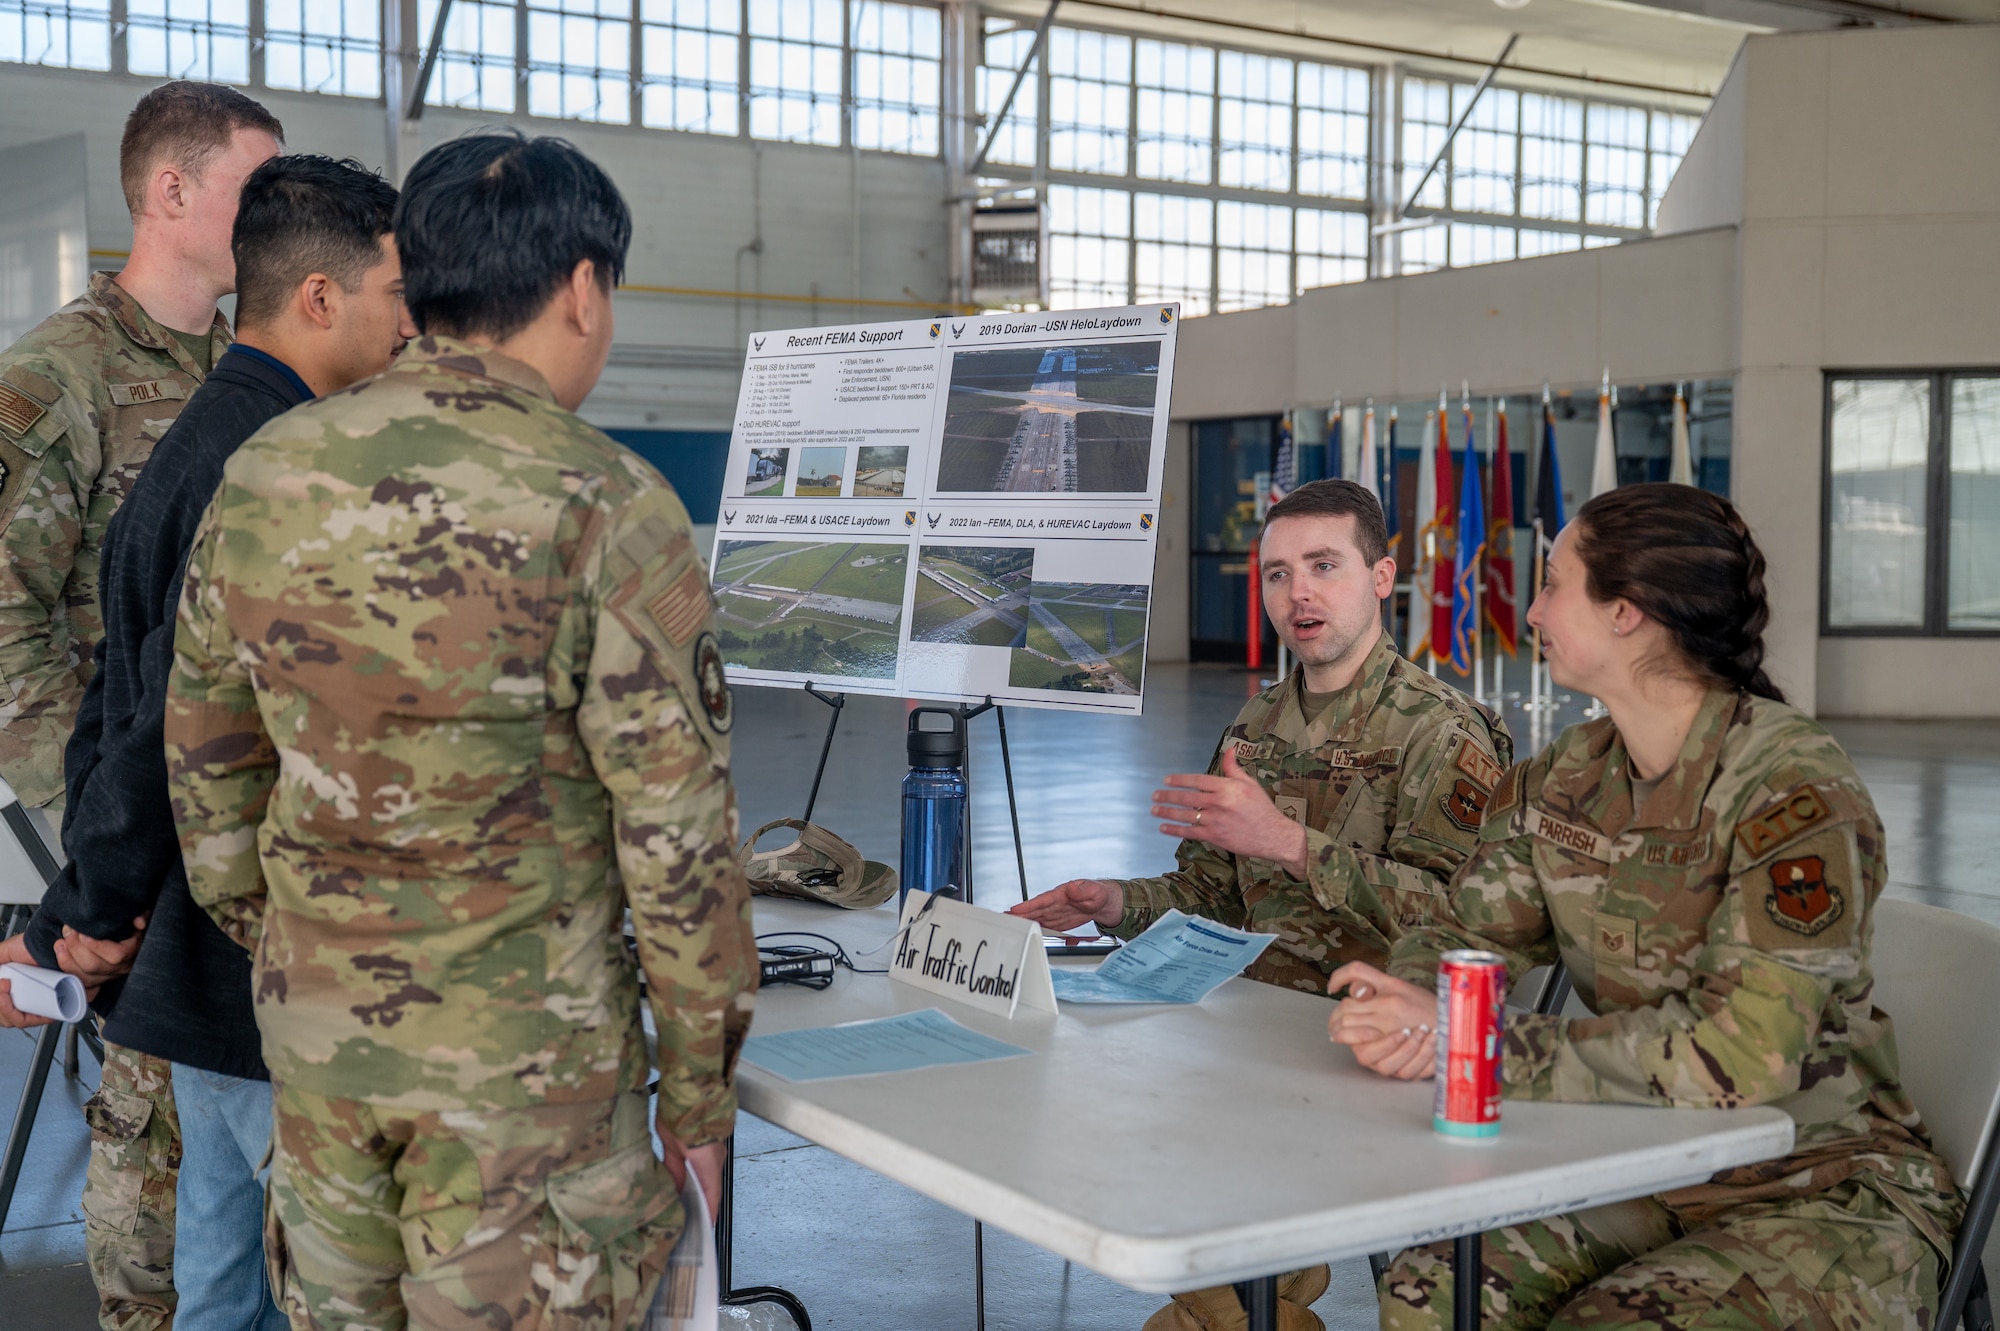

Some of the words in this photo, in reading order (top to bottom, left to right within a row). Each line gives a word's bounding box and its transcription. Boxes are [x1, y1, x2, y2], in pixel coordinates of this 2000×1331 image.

[979, 324, 1002, 336] 2019
[1004, 323, 1036, 334] Dorian
[1070, 317, 1141, 331] HeloLaydown
[787, 335, 823, 347] Recent
[824, 332, 855, 345] FEMA
[859, 329, 904, 344] Support
[129, 382, 162, 401] POLK
[782, 420, 800, 428] support
[746, 515, 764, 524] 2021
[765, 515, 778, 524] Ida
[811, 515, 816, 524] &
[819, 516, 850, 525] USACE
[851, 516, 890, 527] Laydown
[950, 518, 967, 527] 2022
[969, 519, 981, 527] Ian
[1016, 519, 1036, 529] DLA,
[1039, 519, 1044, 528] &
[1047, 520, 1090, 529] HUREVAC
[1092, 520, 1131, 531] Laydown
[1751, 795, 1821, 850] ATC
[1538, 818, 1597, 855] PARRISH
[1183, 941, 1199, 950] Force
[896, 917, 920, 968] Air
[922, 923, 968, 985] Traffic
[969, 940, 1018, 999] Control
